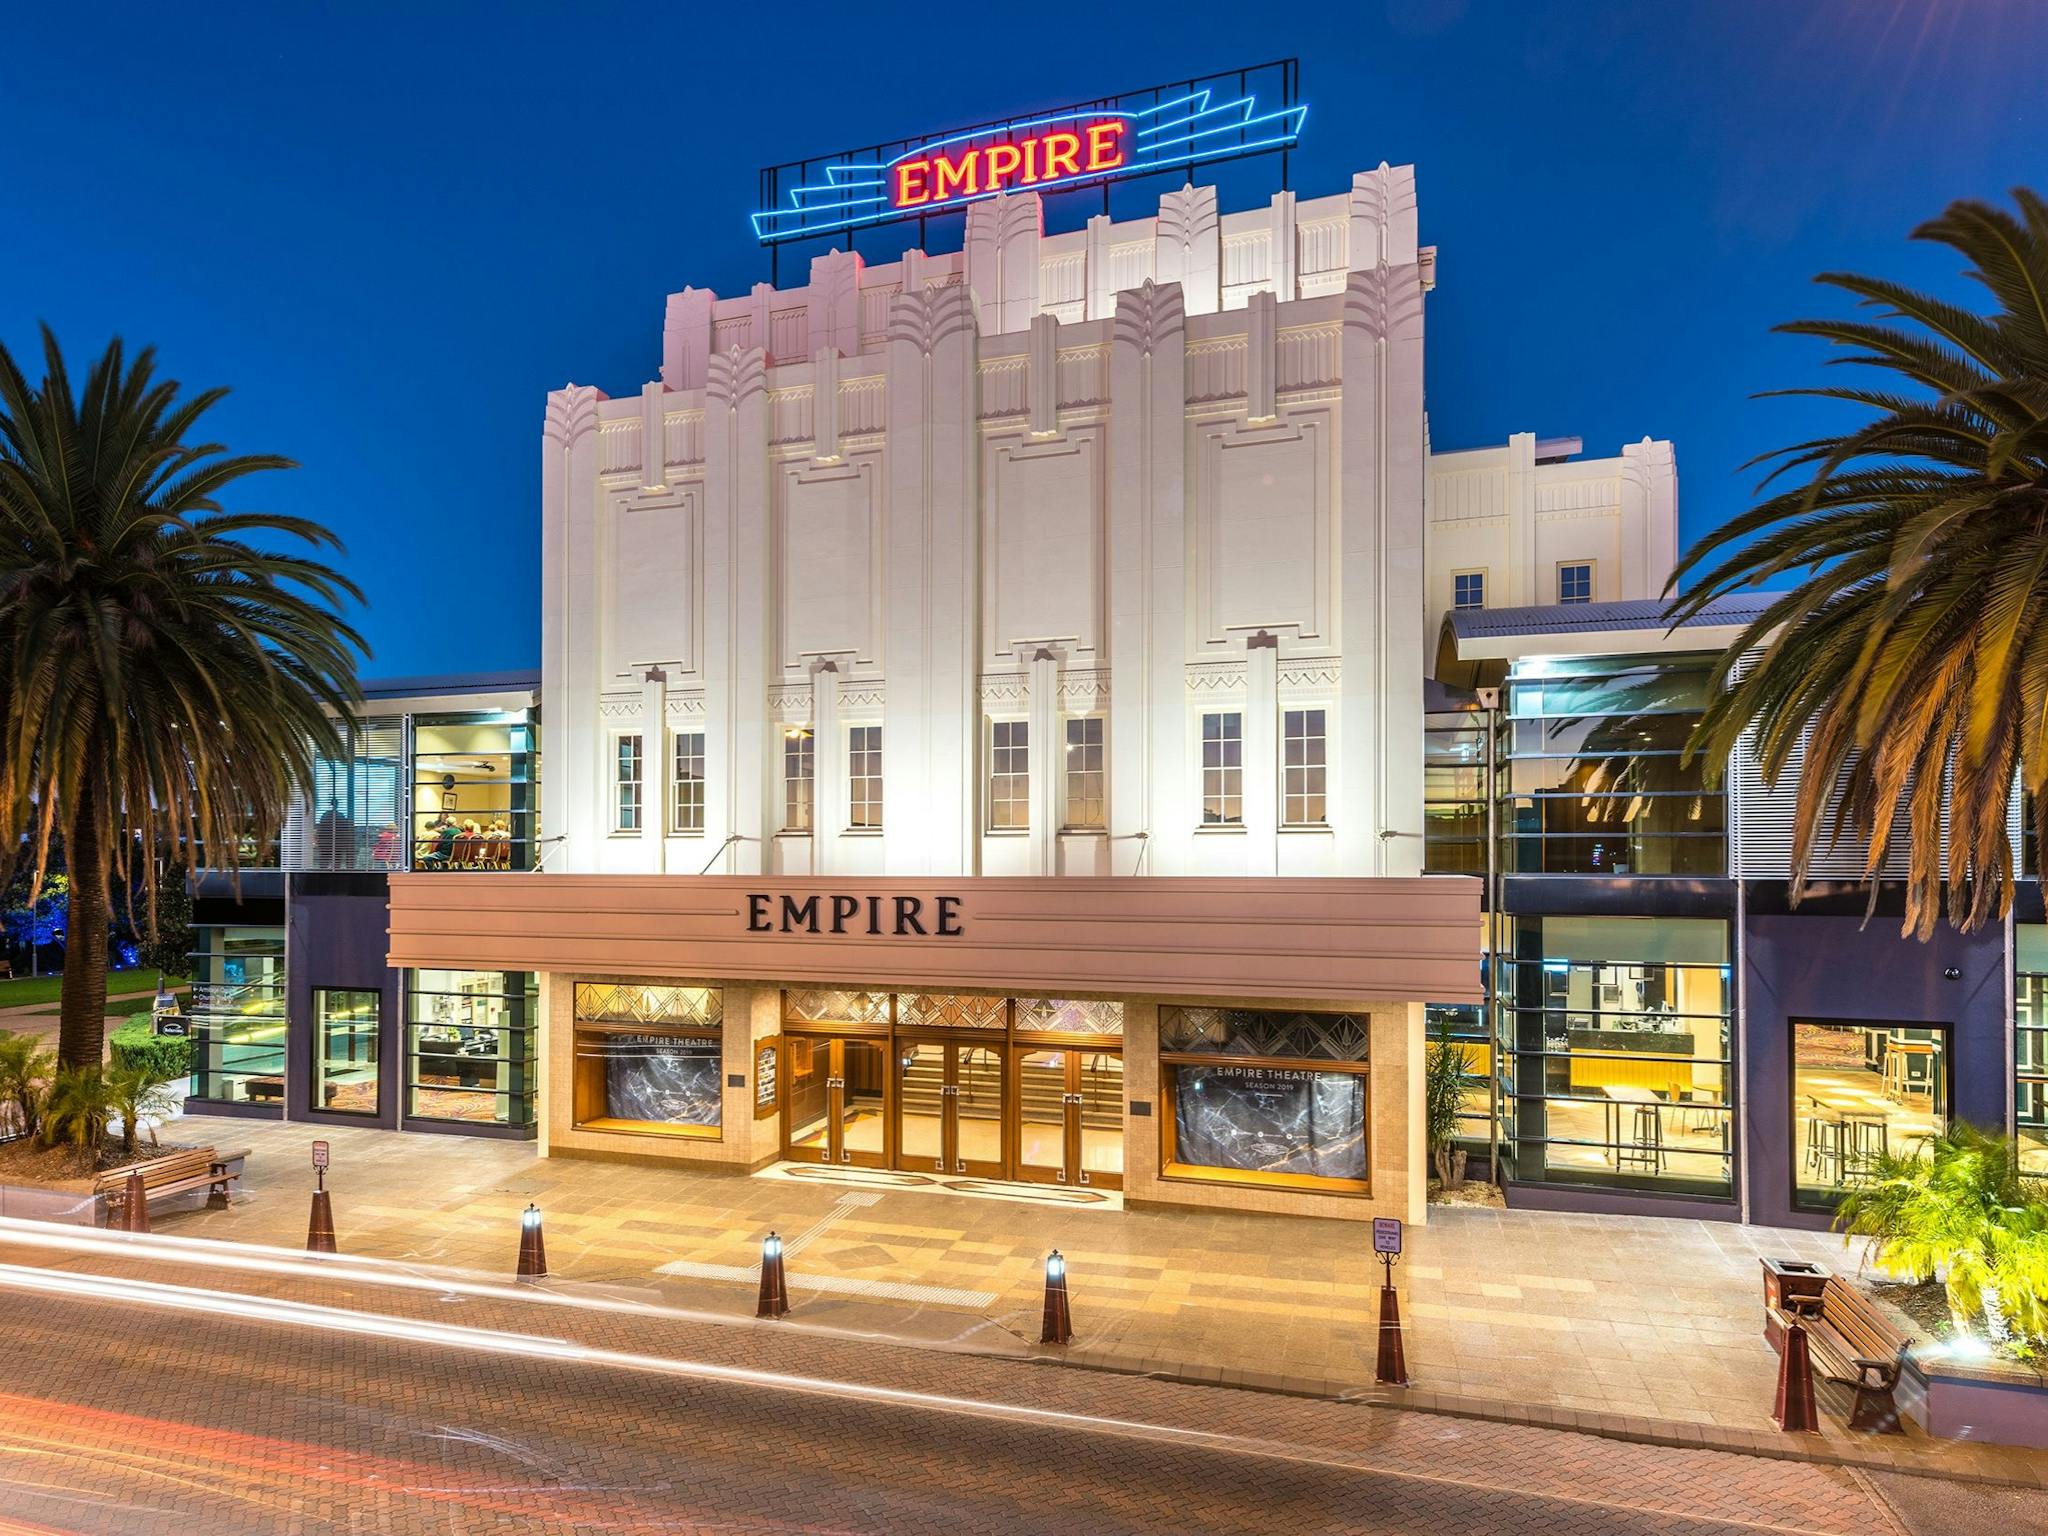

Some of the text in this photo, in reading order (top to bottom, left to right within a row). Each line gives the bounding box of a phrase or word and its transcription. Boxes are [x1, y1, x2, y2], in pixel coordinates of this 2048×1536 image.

[895, 121, 1124, 207] EMPIRE
[746, 894, 964, 936] EMPIRE
[636, 1034, 713, 1048] EMPIRE THEATRE
[656, 1047, 679, 1056] SEASON
[1216, 1067, 1322, 1082] EMPIRE THEATRE
[1245, 1081, 1294, 1091] SEASON 2019
